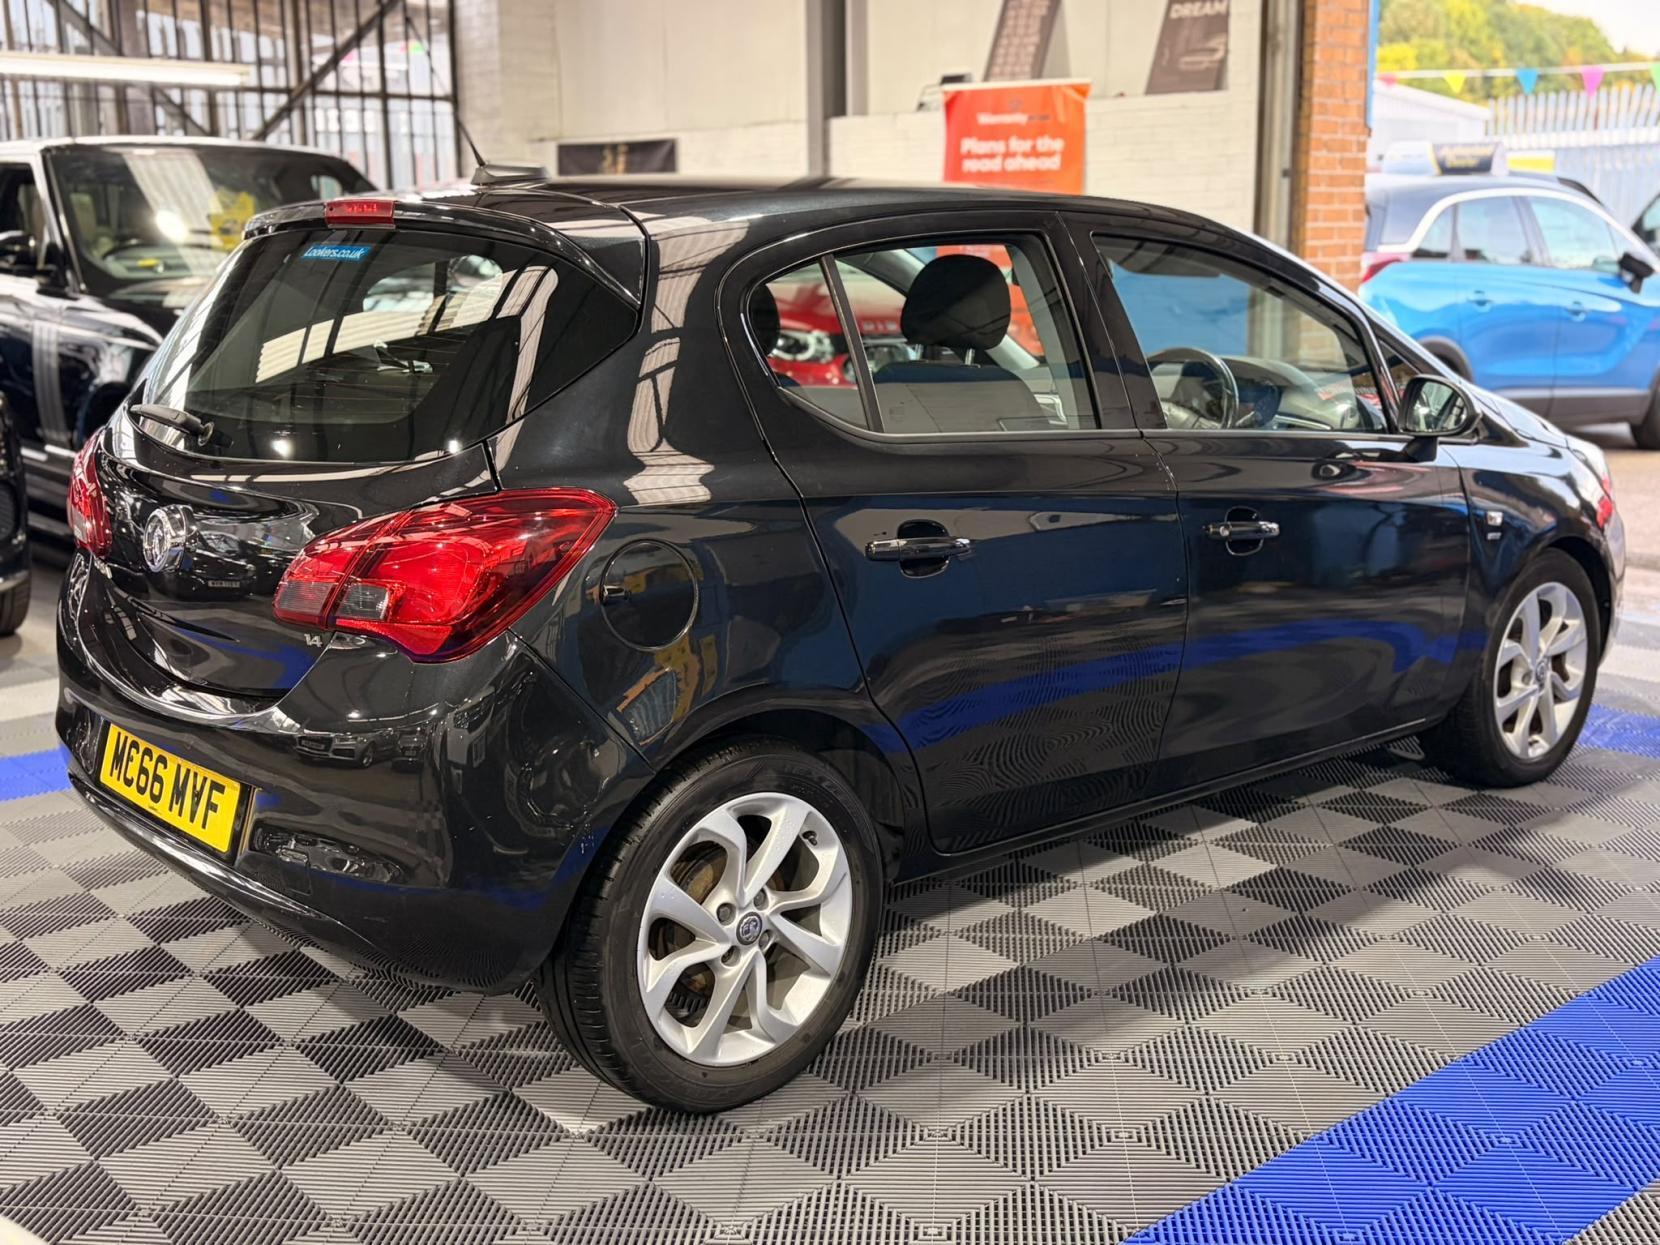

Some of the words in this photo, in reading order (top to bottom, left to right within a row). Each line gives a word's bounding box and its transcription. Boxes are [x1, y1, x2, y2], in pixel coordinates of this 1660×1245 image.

[1168, 1, 1228, 19] DREAM
[960, 136, 1006, 154] Plans
[1008, 135, 1033, 152] for
[1035, 134, 1065, 152] the
[961, 154, 1003, 172] road
[1004, 153, 1061, 172] ahead
[303, 246, 366, 259] Lookers.co.uk
[109, 731, 168, 804] MC66
[169, 764, 226, 830] MVF
